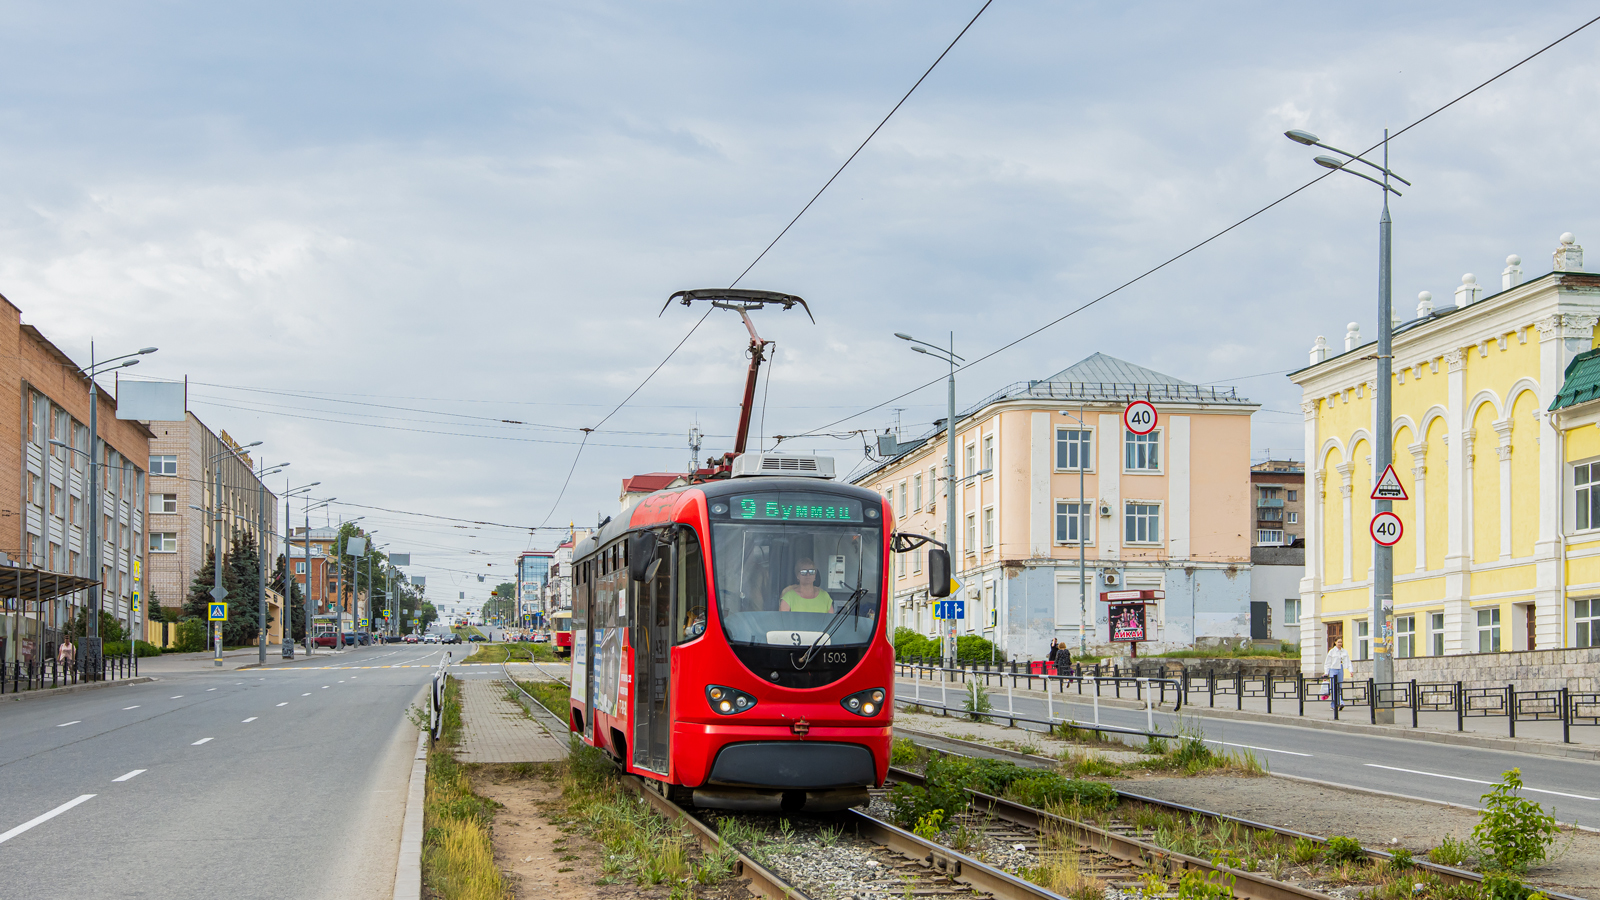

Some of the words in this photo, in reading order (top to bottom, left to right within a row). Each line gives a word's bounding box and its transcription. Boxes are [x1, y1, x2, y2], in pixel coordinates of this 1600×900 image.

[1131, 410, 1151, 424] 40
[741, 499, 756, 519] 9
[1376, 522, 1396, 536] 40
[790, 632, 802, 646] 9
[1114, 629, 1144, 639] АЙКАЙ
[823, 652, 847, 663] 1503
